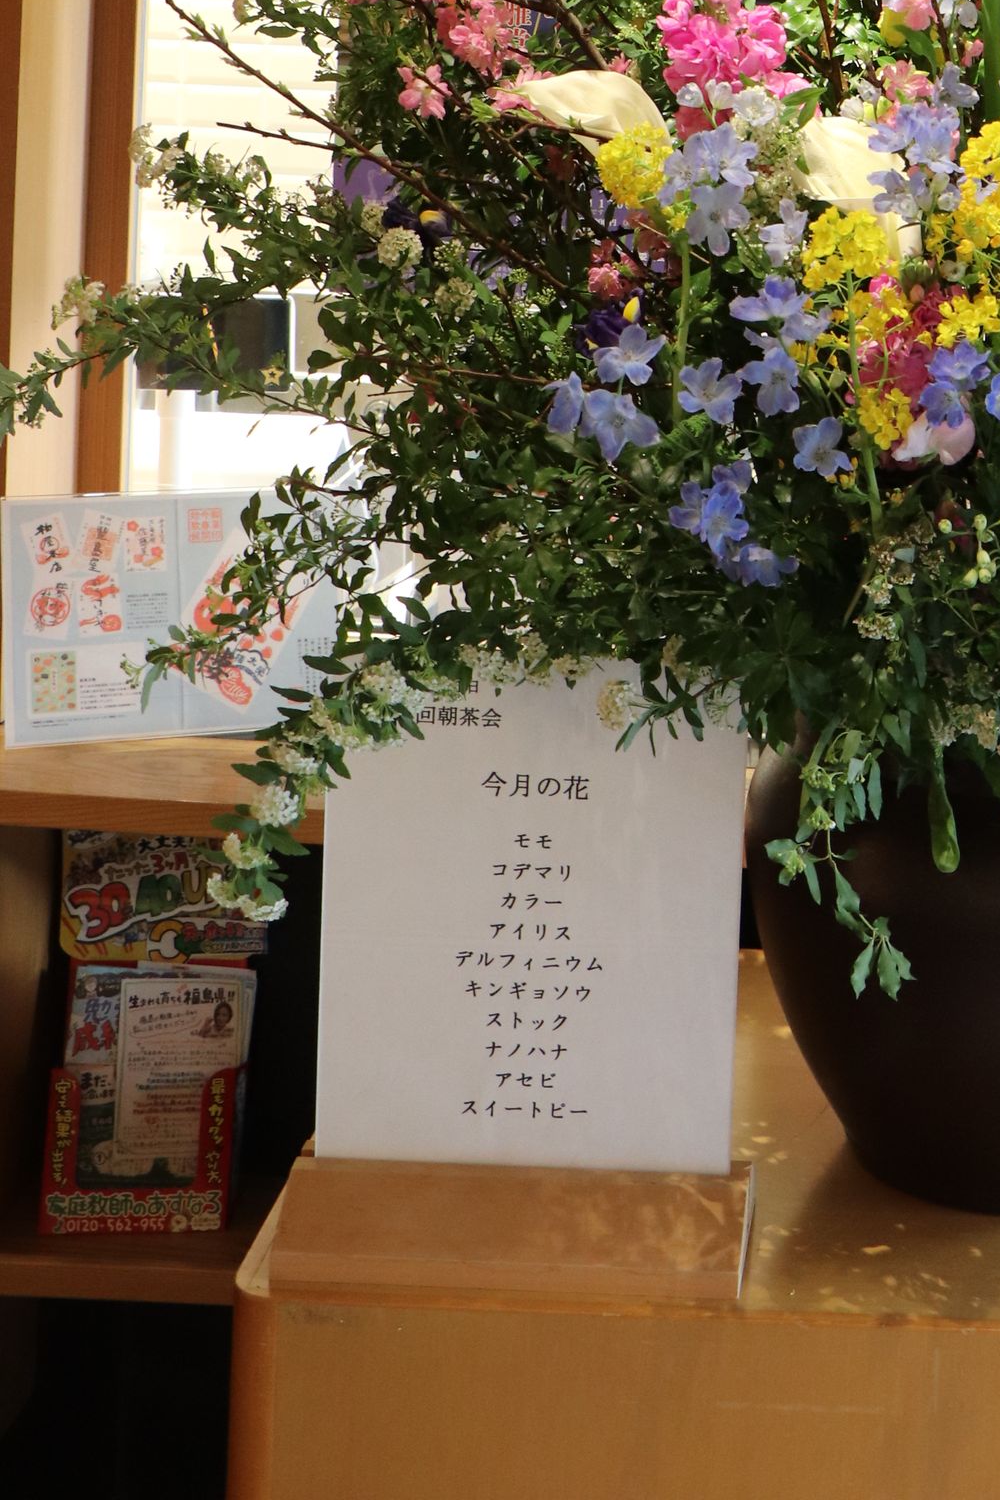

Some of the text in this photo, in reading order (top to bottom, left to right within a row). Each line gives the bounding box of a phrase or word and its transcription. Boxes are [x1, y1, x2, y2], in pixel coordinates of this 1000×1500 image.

[481, 771, 590, 801] 今月の花
[513, 833, 553, 850] モモ
[492, 863, 571, 883] コデマリ
[500, 892, 563, 910] カラー
[489, 923, 571, 941] アイリス
[455, 950, 603, 973] デルフィニウム
[464, 980, 591, 1003] キンギョソウ
[486, 1011, 568, 1032] ストック
[485, 1041, 568, 1061] ナノハナ
[495, 1072, 557, 1089] アセビ
[461, 1100, 588, 1119] スイートピー
[47, 1190, 222, 1218] 家庭教師のあすなろ
[66, 1217, 167, 1234] 0120-562-955
